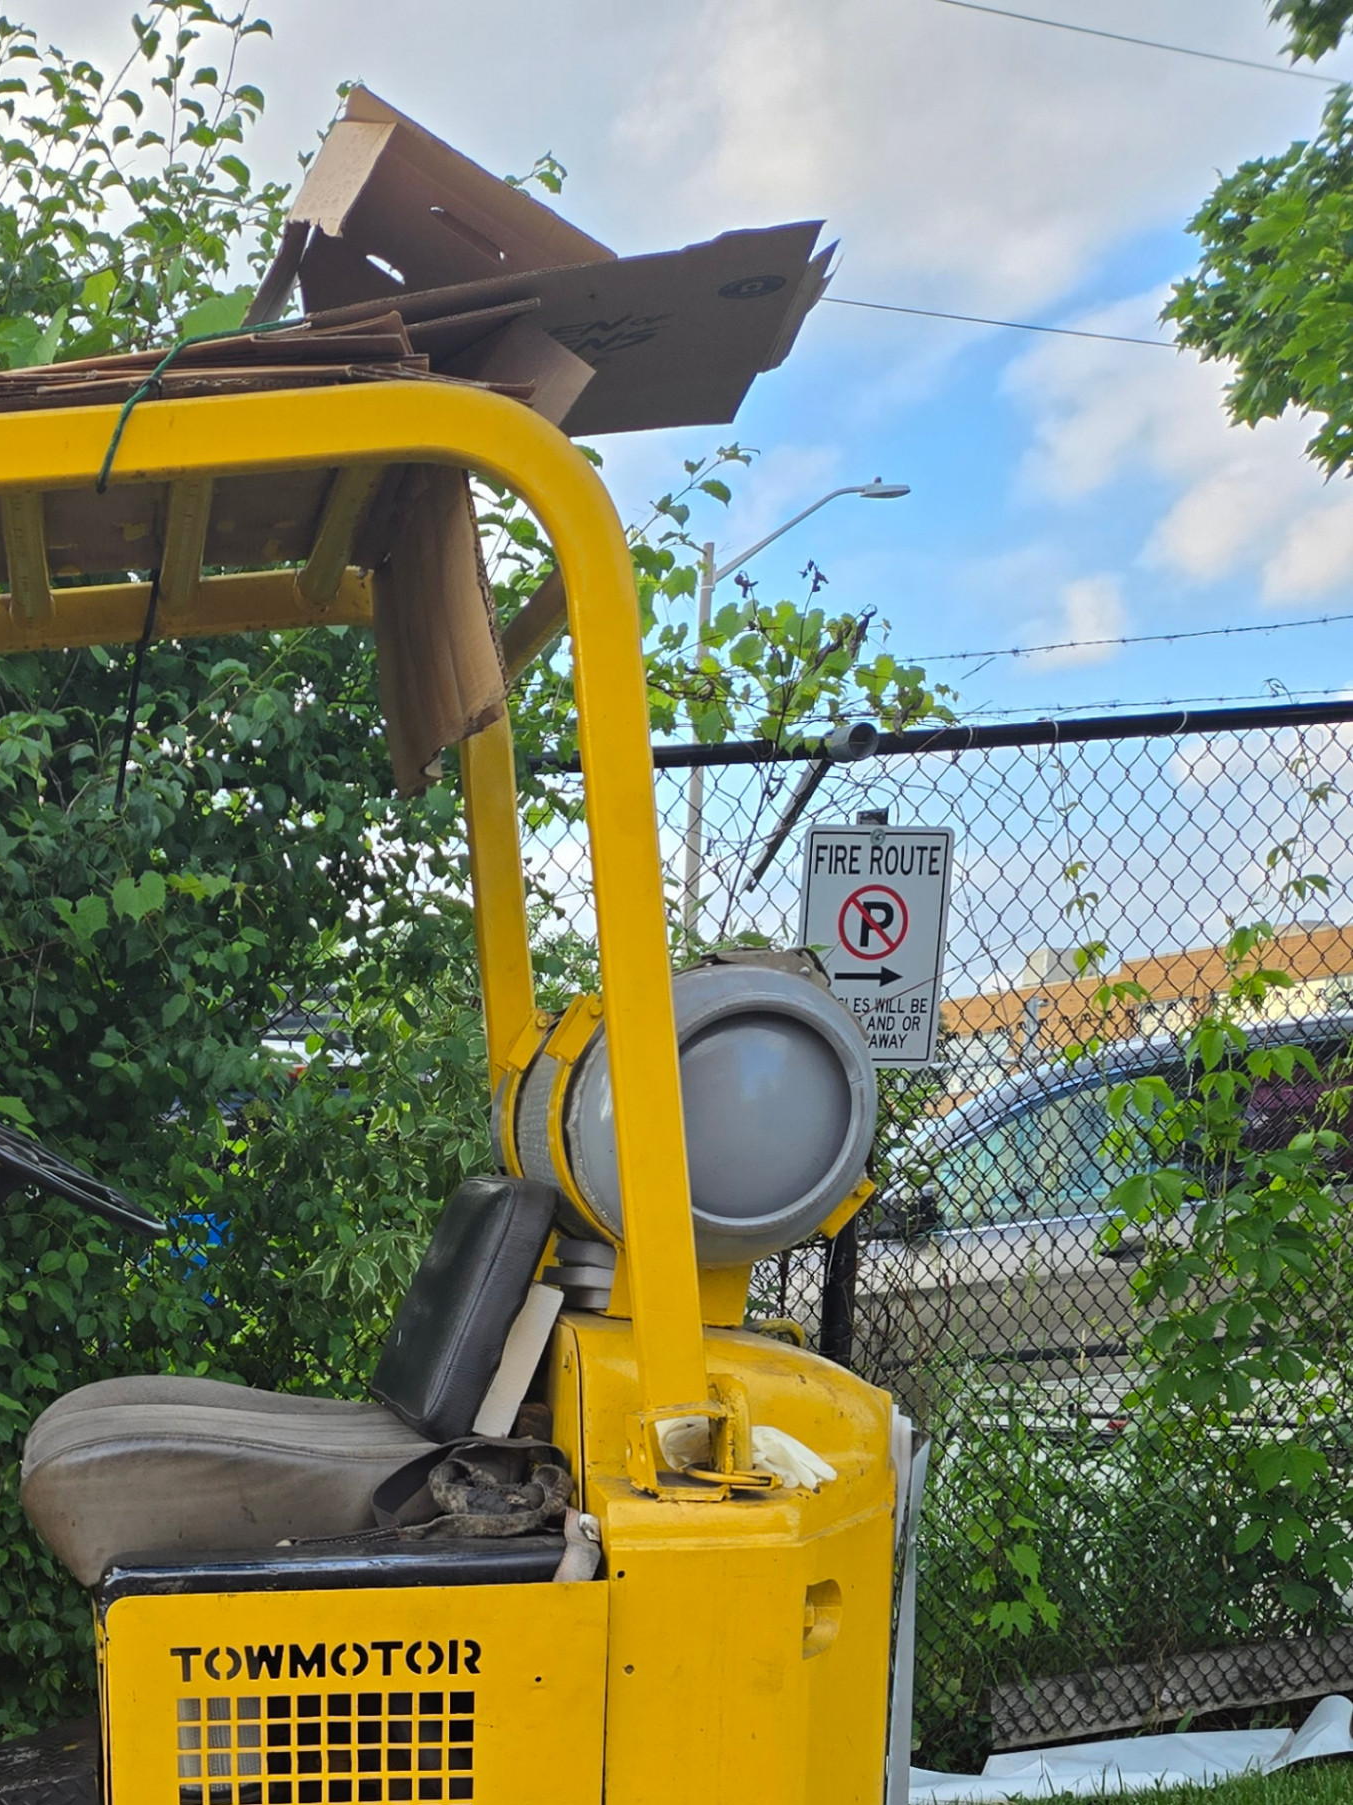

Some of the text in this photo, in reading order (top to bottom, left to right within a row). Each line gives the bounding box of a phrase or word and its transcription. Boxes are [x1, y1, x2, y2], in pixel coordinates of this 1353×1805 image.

[814, 844, 942, 876] FIRE ROUTE
[875, 997, 905, 1014] WILL
[910, 998, 928, 1014] BE
[866, 1016, 896, 1032] AND
[902, 1016, 921, 1032] OR
[868, 1033, 908, 1049] AWAY
[170, 1639, 482, 1683] TOWMOTOR
